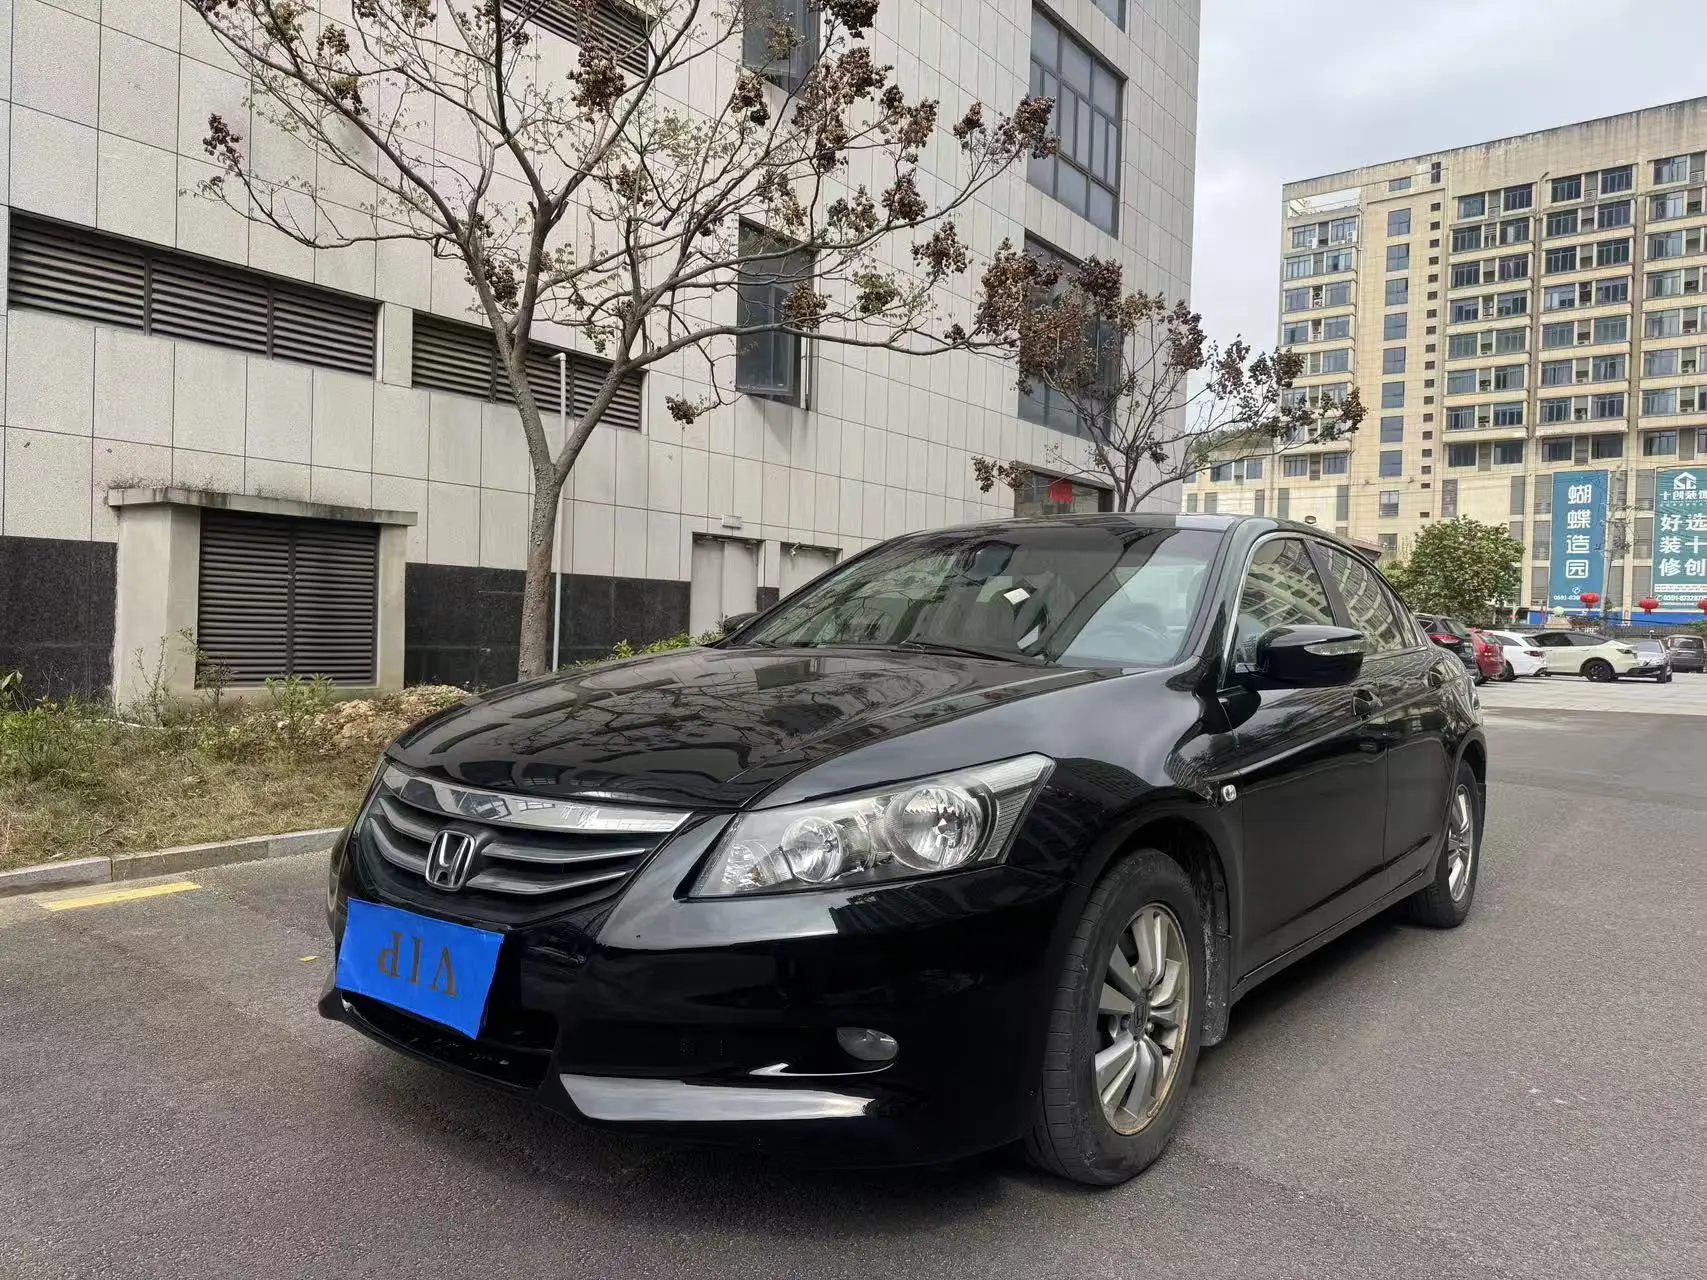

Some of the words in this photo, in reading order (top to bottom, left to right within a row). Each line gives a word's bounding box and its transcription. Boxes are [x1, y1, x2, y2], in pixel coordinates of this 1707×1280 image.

[1565, 484, 1592, 579] 蝴蝶造园
[377, 930, 457, 997] VIP
